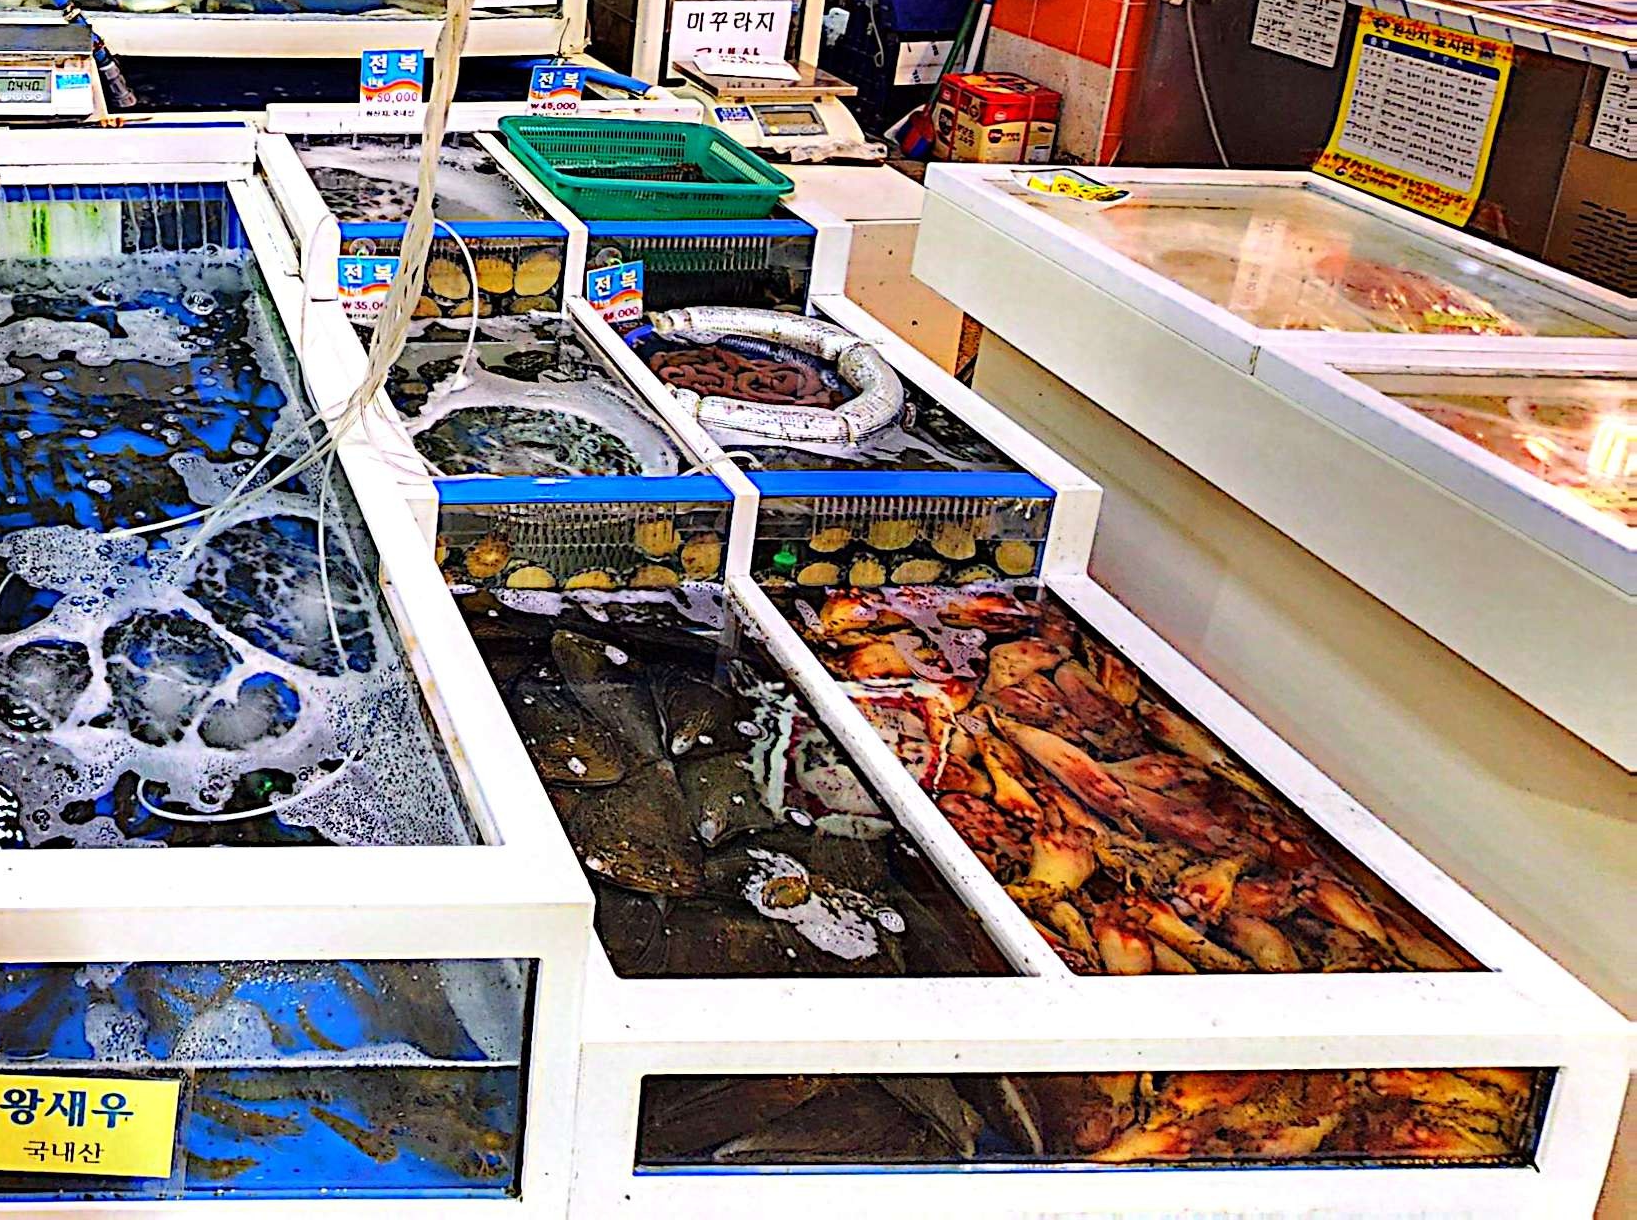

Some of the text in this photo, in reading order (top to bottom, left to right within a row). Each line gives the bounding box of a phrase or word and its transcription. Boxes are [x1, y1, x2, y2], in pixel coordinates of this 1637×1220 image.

[686, 11, 776, 33] 미꾸라지
[368, 53, 419, 75] 전복
[537, 71, 580, 89] 전복
[343, 263, 394, 284] 전복
[594, 269, 638, 297] 전복
[22, 1139, 106, 1164] 국내산
